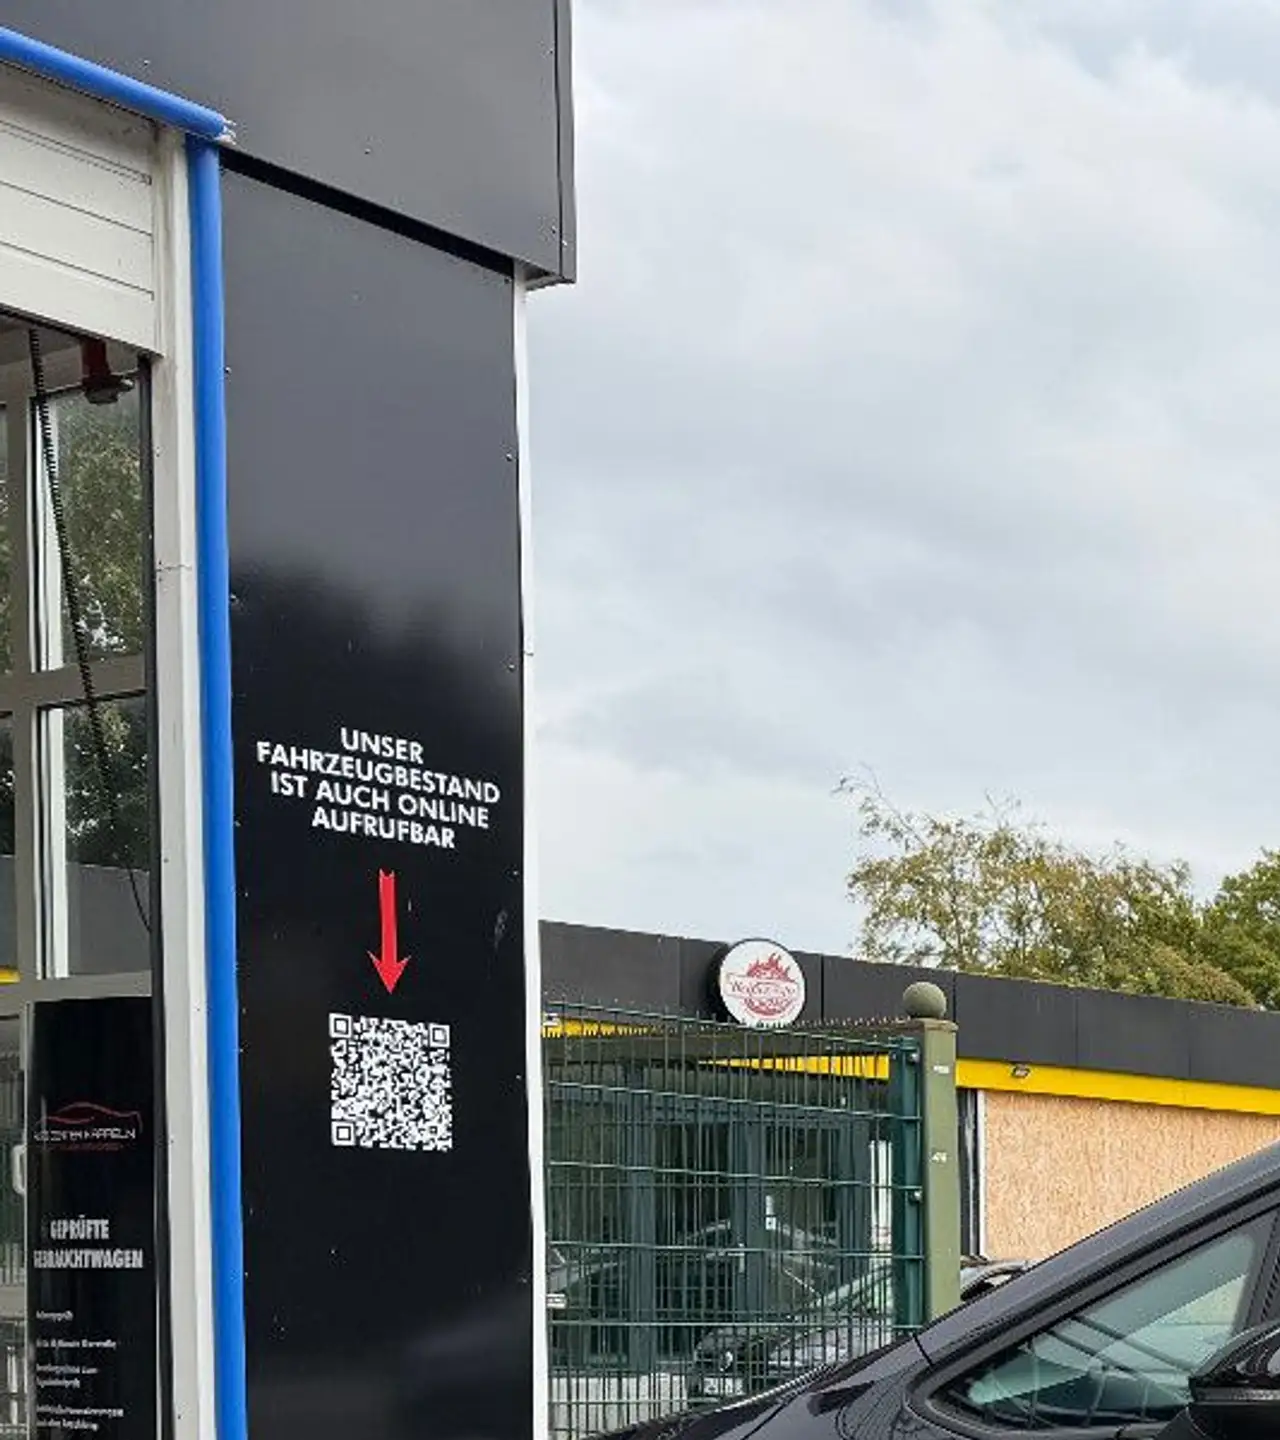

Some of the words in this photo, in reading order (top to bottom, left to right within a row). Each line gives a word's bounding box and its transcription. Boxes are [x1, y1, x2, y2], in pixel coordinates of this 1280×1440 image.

[340, 727, 424, 764] UNSER
[256, 741, 501, 804] FAHRZEUGBESTAND
[271, 770, 308, 798] IST
[315, 782, 390, 811] AUCH
[398, 795, 489, 829] ONLINE
[312, 805, 455, 849] AUFRUFBAR
[51, 1215, 109, 1240] GEPRÜFTE
